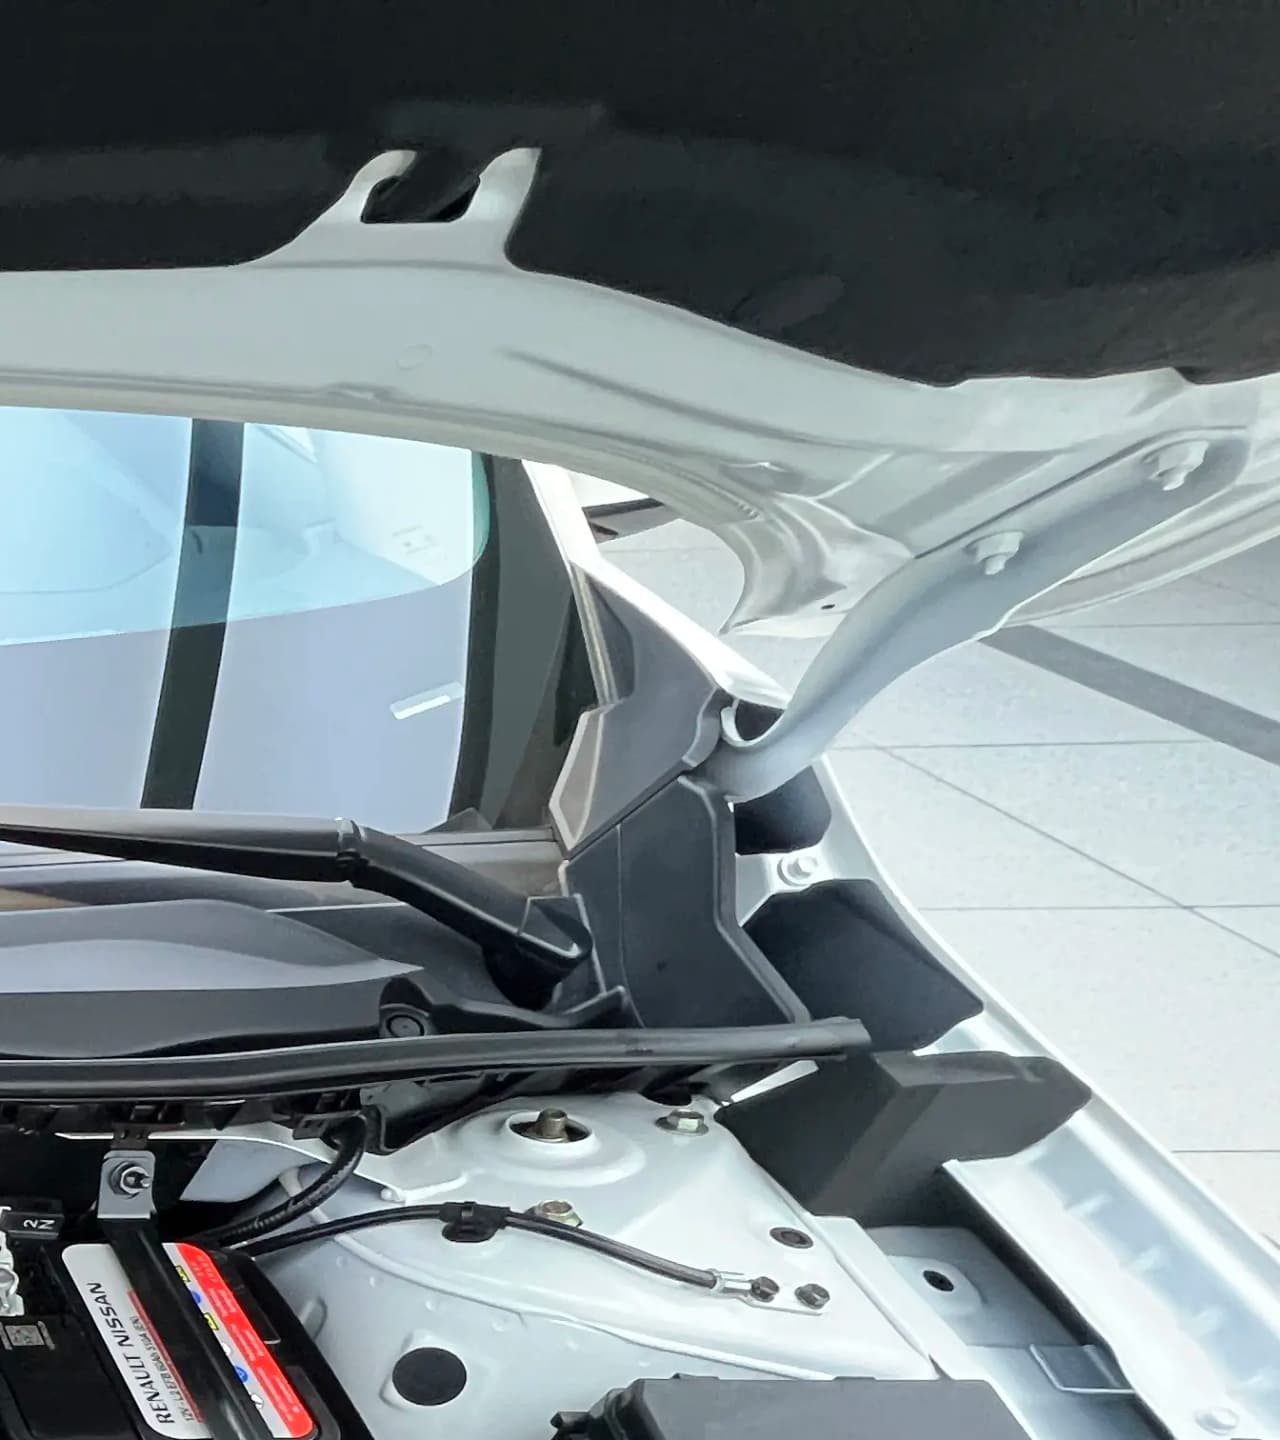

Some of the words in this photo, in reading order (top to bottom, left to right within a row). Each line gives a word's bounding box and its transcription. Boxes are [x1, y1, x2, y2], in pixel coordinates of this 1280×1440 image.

[86, 1282, 133, 1346] NISSAN
[123, 1354, 175, 1423] RENAULT
[157, 1373, 177, 1388] EFB
